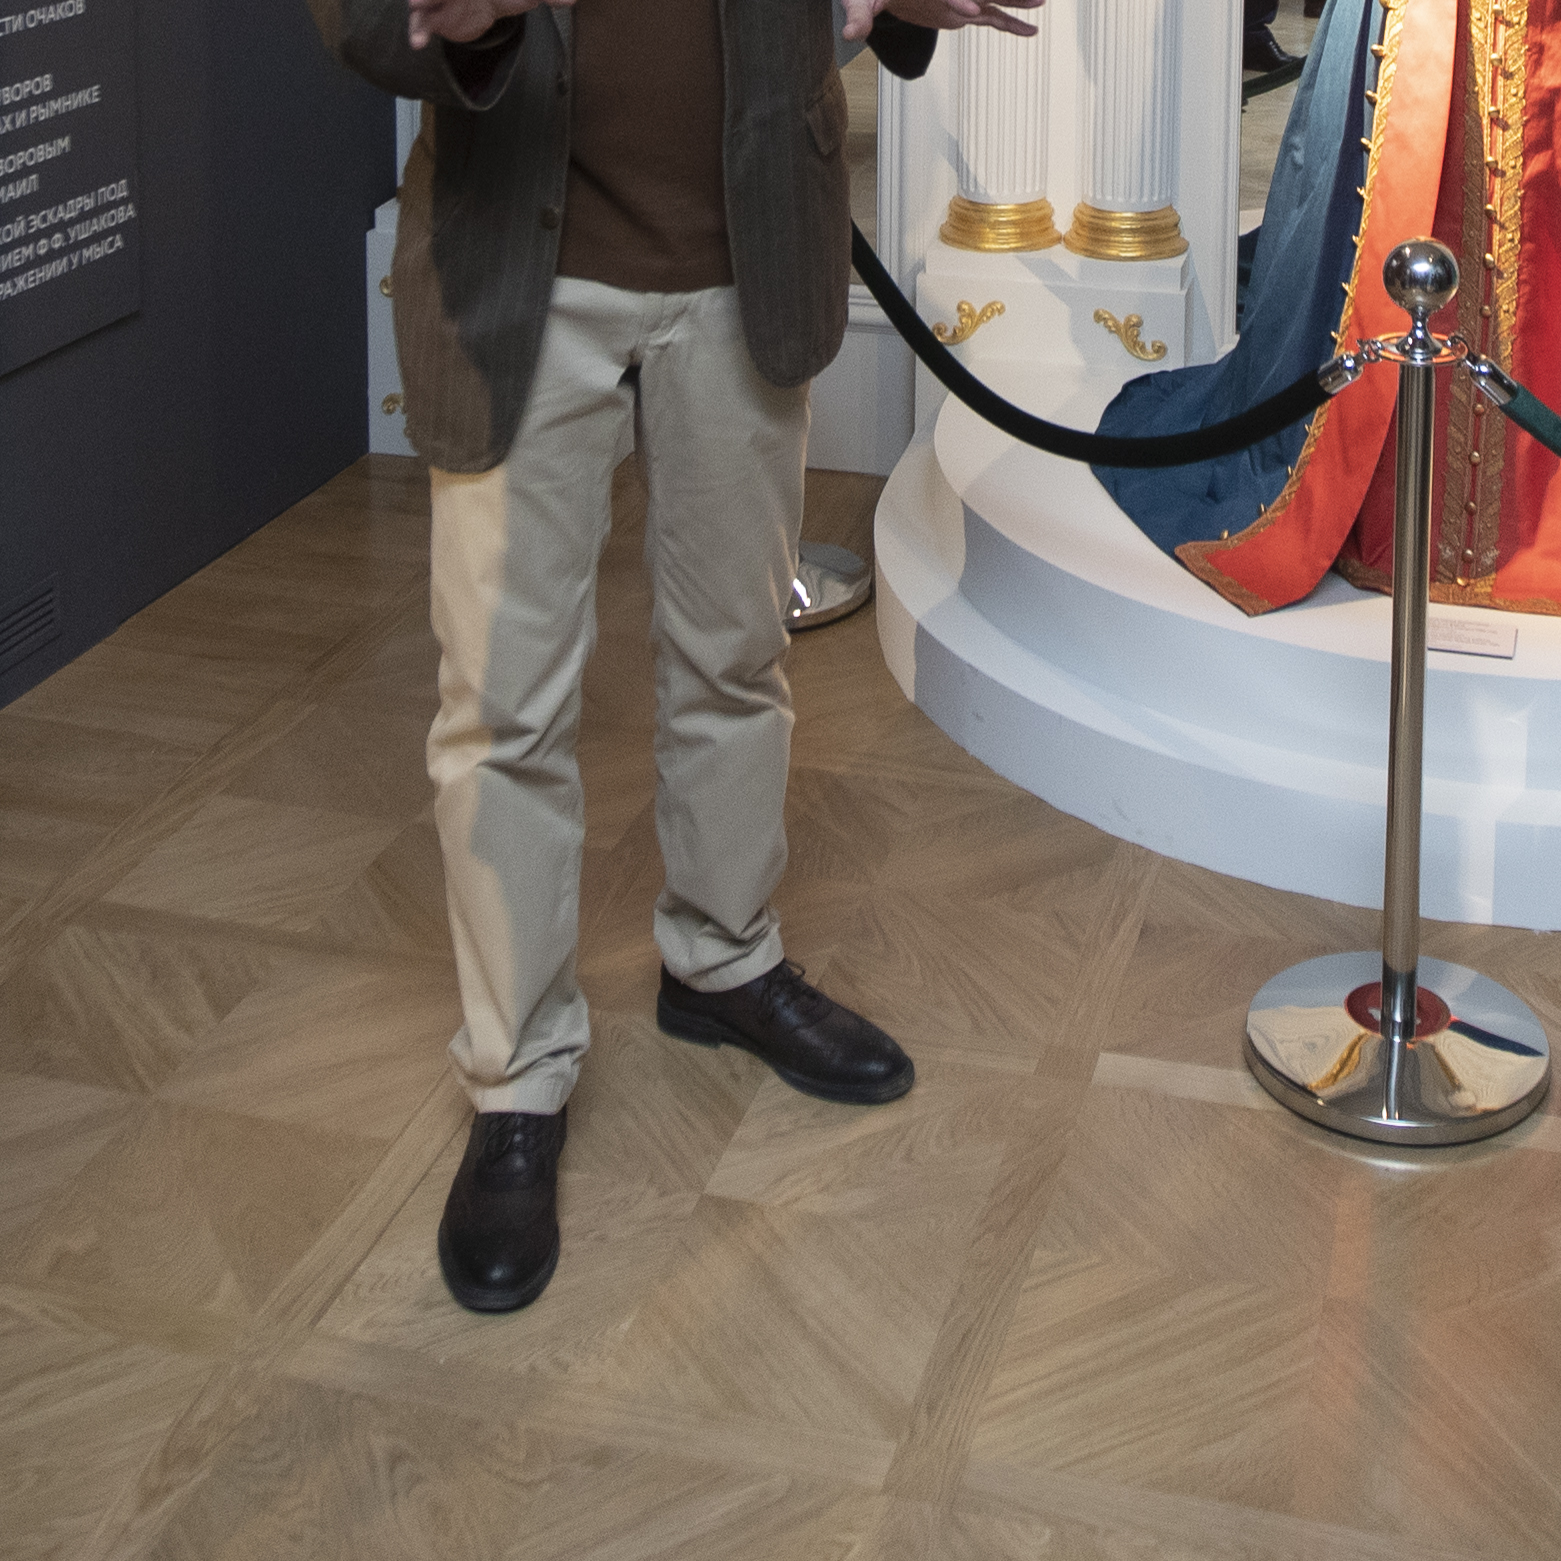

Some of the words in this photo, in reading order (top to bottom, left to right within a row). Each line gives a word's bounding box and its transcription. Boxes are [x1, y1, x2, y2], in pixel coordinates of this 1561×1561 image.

[15, 109, 27, 129] И
[29, 84, 102, 124] РЫМНИКЕ
[27, 193, 96, 234] ЭСКАДРЫ
[97, 179, 129, 204] ПОД
[67, 203, 137, 244] УШАКОВА
[69, 250, 81, 270] У
[82, 233, 124, 265] МЫСА
